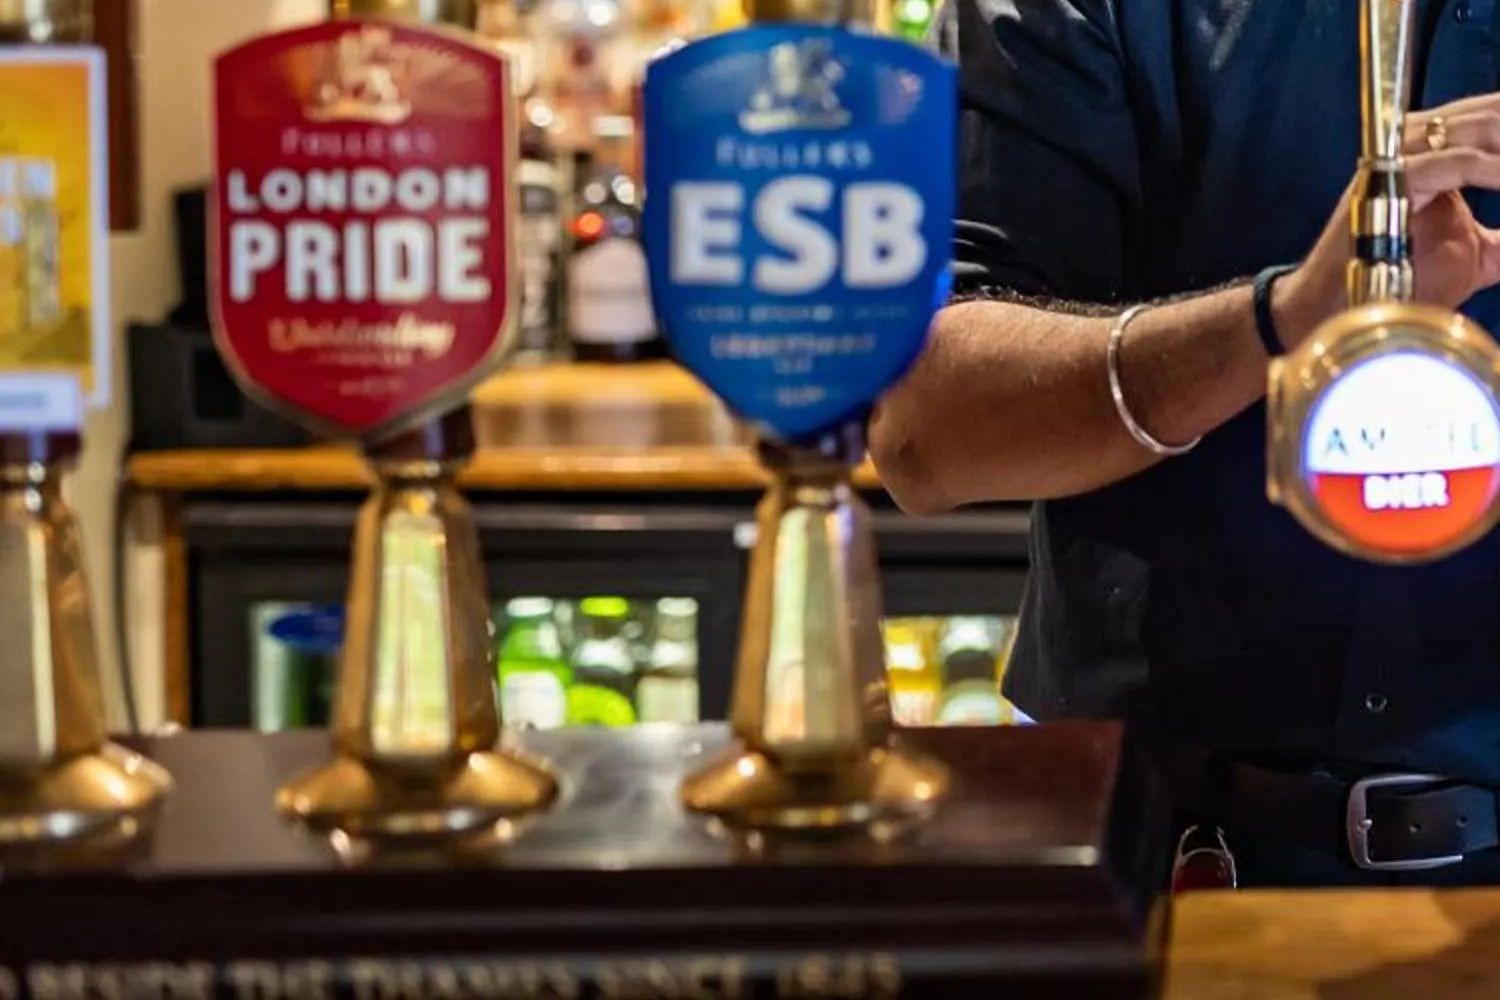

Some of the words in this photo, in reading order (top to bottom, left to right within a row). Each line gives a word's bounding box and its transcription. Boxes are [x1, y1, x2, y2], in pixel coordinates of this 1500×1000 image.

[227, 166, 490, 213] LONDON
[229, 217, 492, 304] PRIDE
[669, 175, 927, 295] ESB
